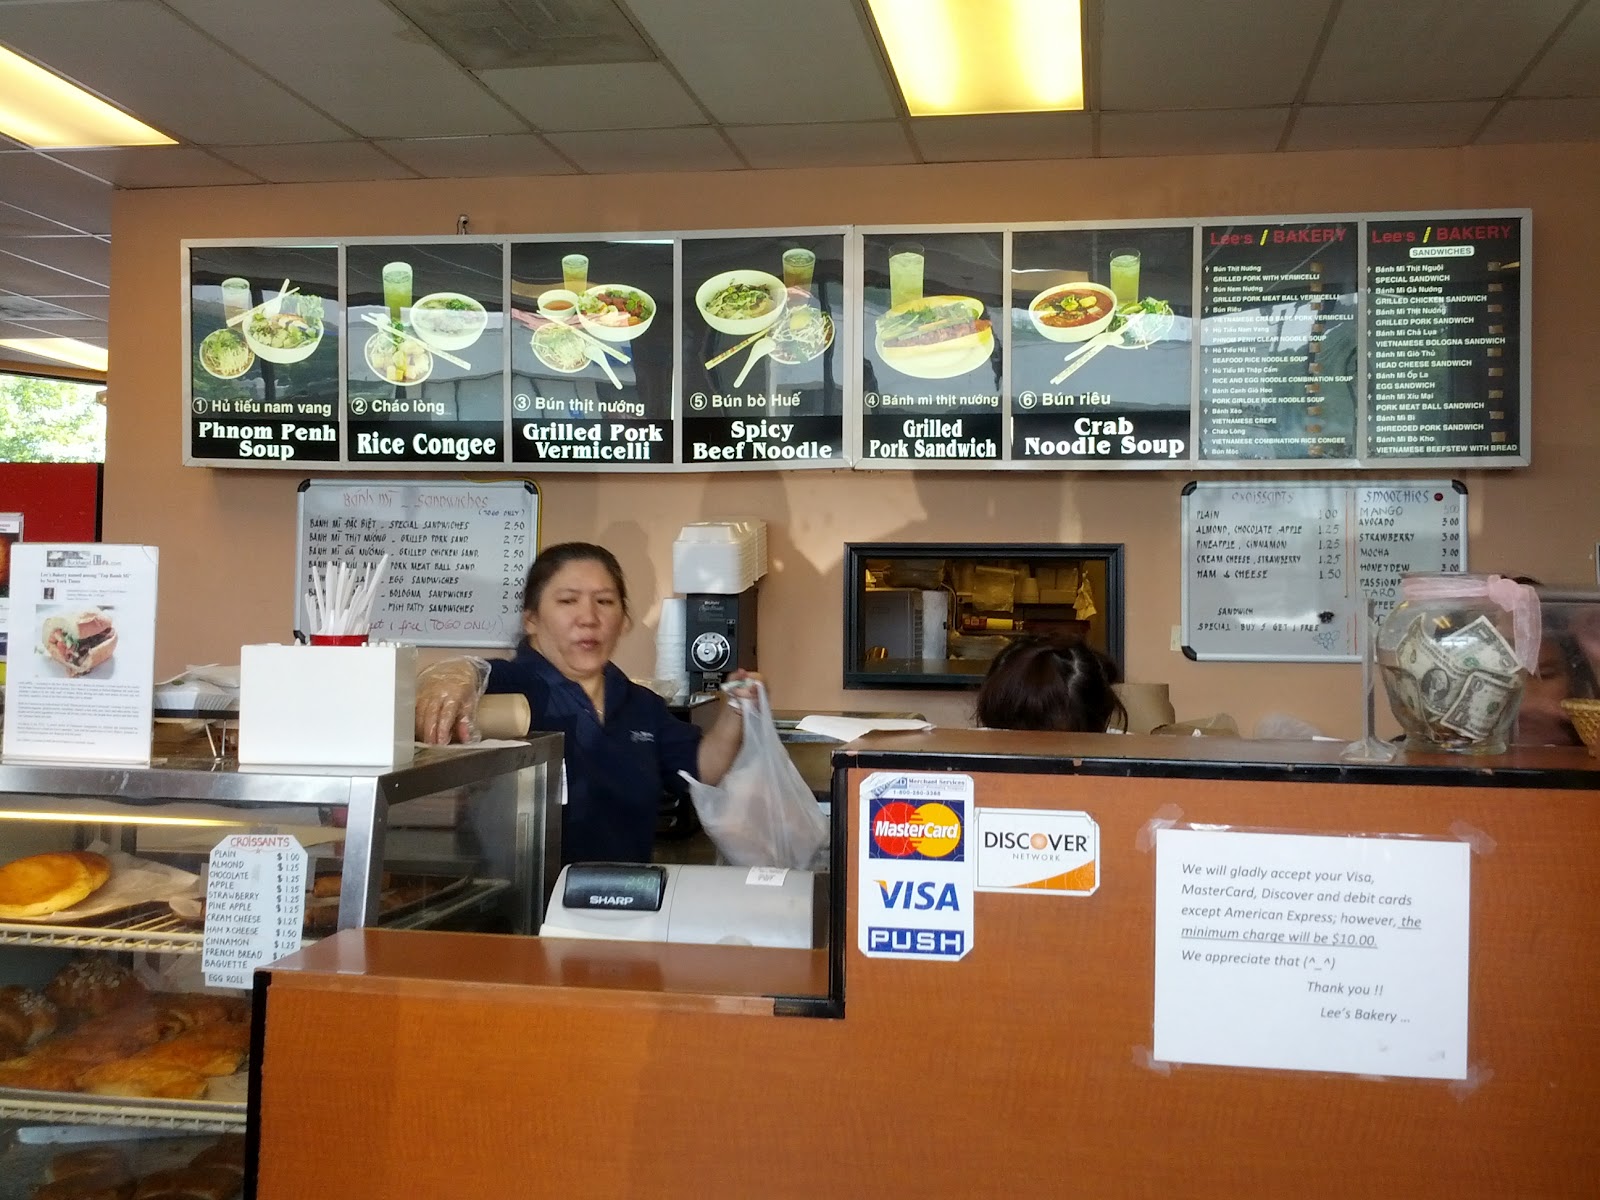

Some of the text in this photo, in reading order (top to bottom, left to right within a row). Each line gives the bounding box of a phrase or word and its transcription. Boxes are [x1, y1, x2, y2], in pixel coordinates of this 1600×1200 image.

[1210, 228, 1346, 245] Lee's BAKERY
[1372, 226, 1512, 243] Lee's BAKERY
[1412, 247, 1472, 256] SANDWICHES
[1042, 392, 1074, 406] Bún
[1080, 391, 1111, 405] riêu
[372, 399, 409, 413] Cháo
[413, 399, 445, 416] lòng
[198, 422, 336, 441] Phnom Penh
[523, 423, 664, 442] Grilled Pork
[731, 420, 794, 442] Spicy
[903, 419, 962, 438] Grilled
[1074, 417, 1134, 436] Crab
[239, 440, 295, 460] Soup
[357, 431, 496, 461] Rice Congee
[535, 441, 650, 460] Vermicelli
[693, 442, 832, 460] Beef Noodle
[869, 438, 996, 458] Pork Sandwich
[1024, 435, 1185, 458] Noodle Soup
[1360, 506, 1403, 517] MANGO
[1359, 533, 1415, 542] STRAWBERRY
[1360, 549, 1389, 557] MOCHA
[1197, 570, 1216, 578] HAM
[1235, 570, 1268, 578] CHEESE
[1363, 588, 1396, 598] TARO
[875, 821, 959, 839] MasterCard
[231, 837, 290, 847] CROISSANTS
[984, 832, 1088, 852] DISCOVER
[215, 850, 236, 858] PLAIN
[1013, 853, 1060, 861] NETWORK
[210, 871, 248, 880] CHOCOLATE
[1182, 864, 1375, 885] We will gladly accept your Visa,
[209, 892, 259, 900] STRAWBERRY
[590, 896, 633, 905] SHARP
[873, 879, 960, 911] VISA
[1181, 884, 1412, 906] MasterCard, Discover and debit cards
[207, 914, 261, 923] CREAM CHEESE
[1181, 906, 1421, 929] except American Express; however, the
[206, 938, 249, 946] CINNAMON
[871, 930, 961, 951] PUSH
[1181, 926, 1378, 948] minimum charge will be $10.00.
[206, 948, 262, 959] FRENCH BREAD
[1181, 950, 1202, 961] We
[1205, 952, 1271, 966] appreciate
[1274, 955, 1300, 967] that
[205, 959, 247, 969] BAGUETTE
[209, 974, 243, 984] EGG ROLL
[1307, 982, 1384, 996] Thank you !!
[1355, 1009, 1397, 1023] Bakery
